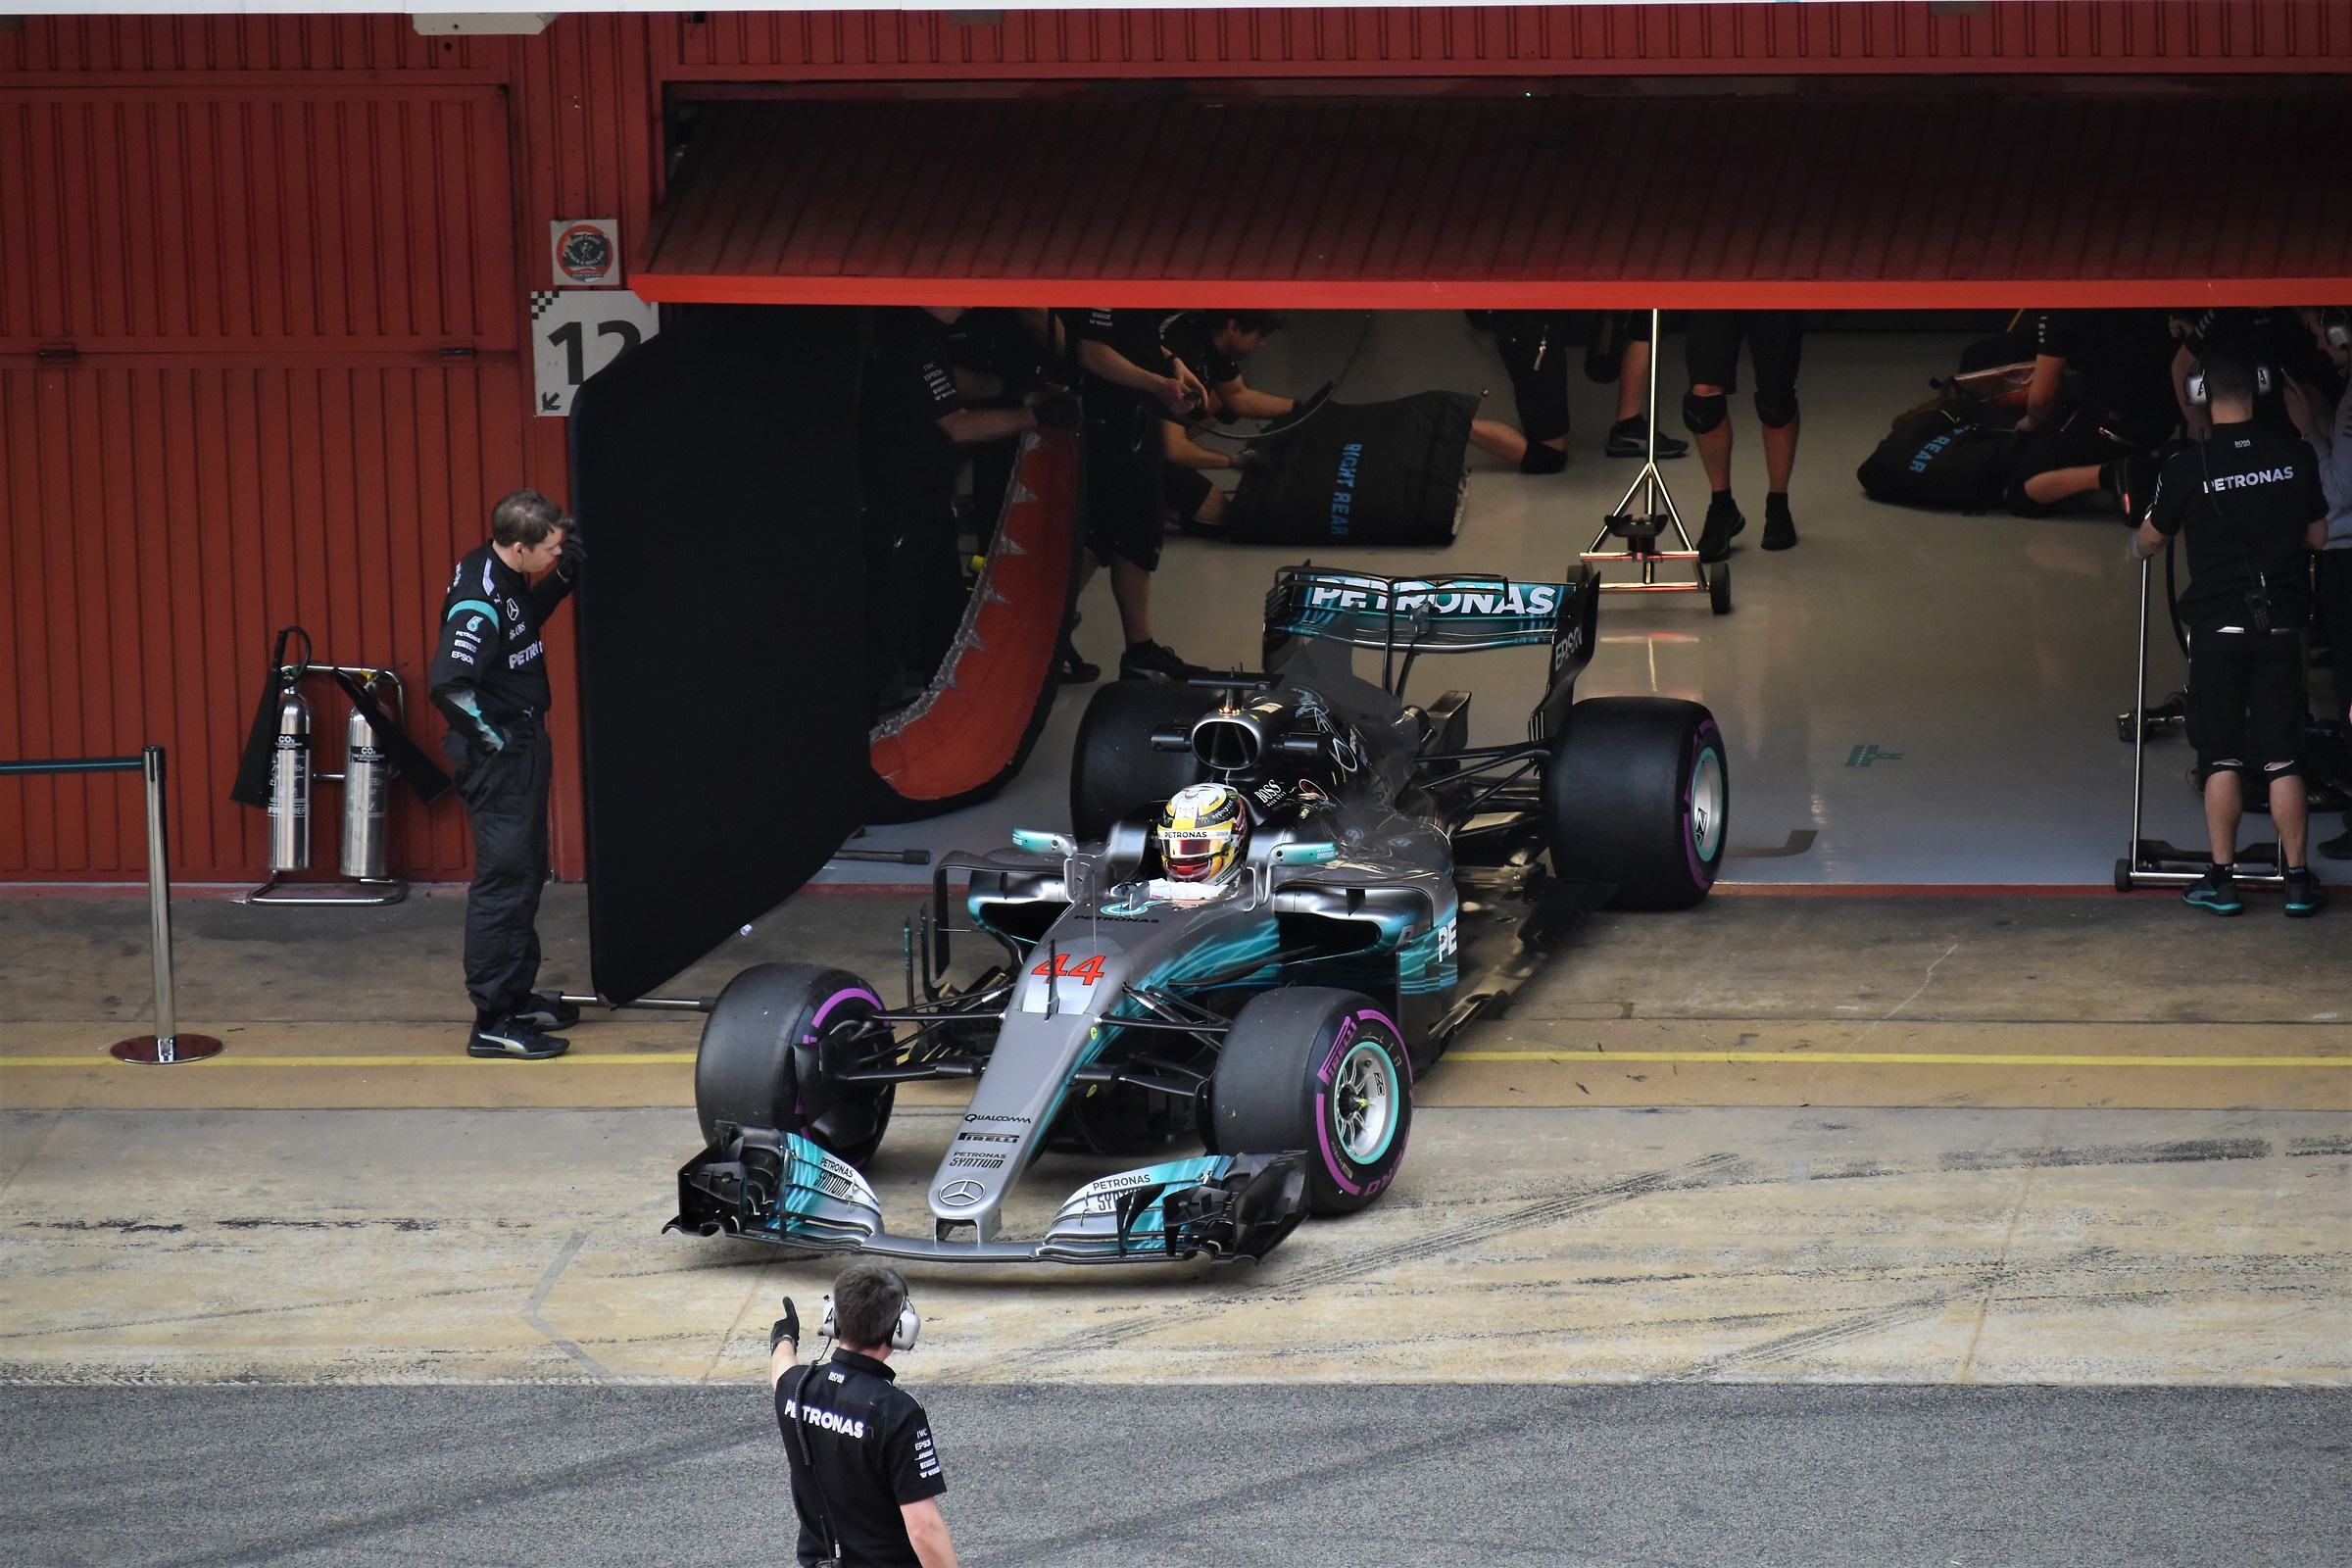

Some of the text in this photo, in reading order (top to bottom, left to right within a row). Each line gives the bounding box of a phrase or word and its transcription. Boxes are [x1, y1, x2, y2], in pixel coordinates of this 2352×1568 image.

[1908, 435, 1951, 472] REAR
[1331, 443, 1363, 535] RIGHT REAR
[1311, 577, 1556, 614] PETRONAS
[1555, 625, 1583, 671] EPSON
[1254, 779, 1282, 804] BOSS
[1074, 915, 1160, 924] PETRONAS
[1031, 954, 1106, 986] 44
[964, 1113, 1031, 1124] QUALCOMM
[957, 1132, 1020, 1144] PIRELLI
[949, 1156, 1004, 1169] SYNTIUM
[954, 1151, 1006, 1159] PETRONAS
[820, 1156, 854, 1178] PETRONAS
[813, 1170, 853, 1198] SYNTIUM
[1093, 1174, 1151, 1191] PETRONAS
